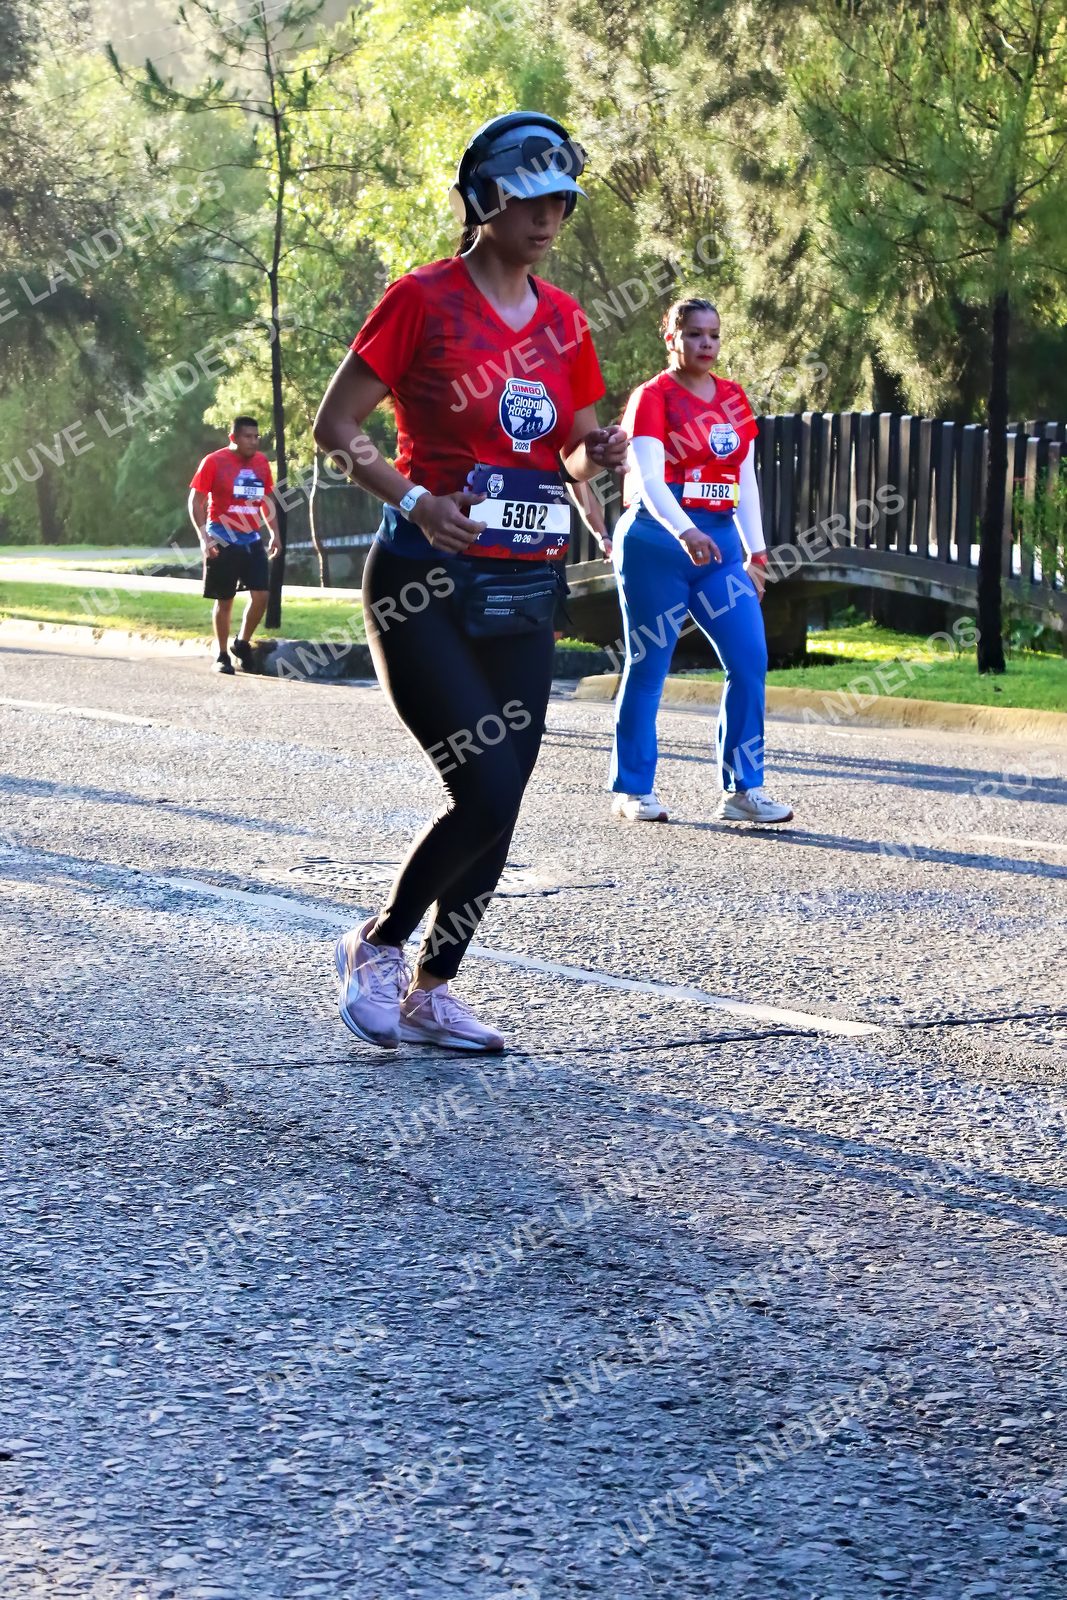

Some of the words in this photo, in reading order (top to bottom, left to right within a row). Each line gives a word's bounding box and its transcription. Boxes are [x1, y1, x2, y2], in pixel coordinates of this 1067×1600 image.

[511, 384, 541, 395] BIMBO
[513, 396, 543, 411] Global
[508, 404, 532, 418] Race
[514, 441, 530, 451] 2026
[701, 484, 730, 499] 17582
[502, 502, 548, 530] 5302
